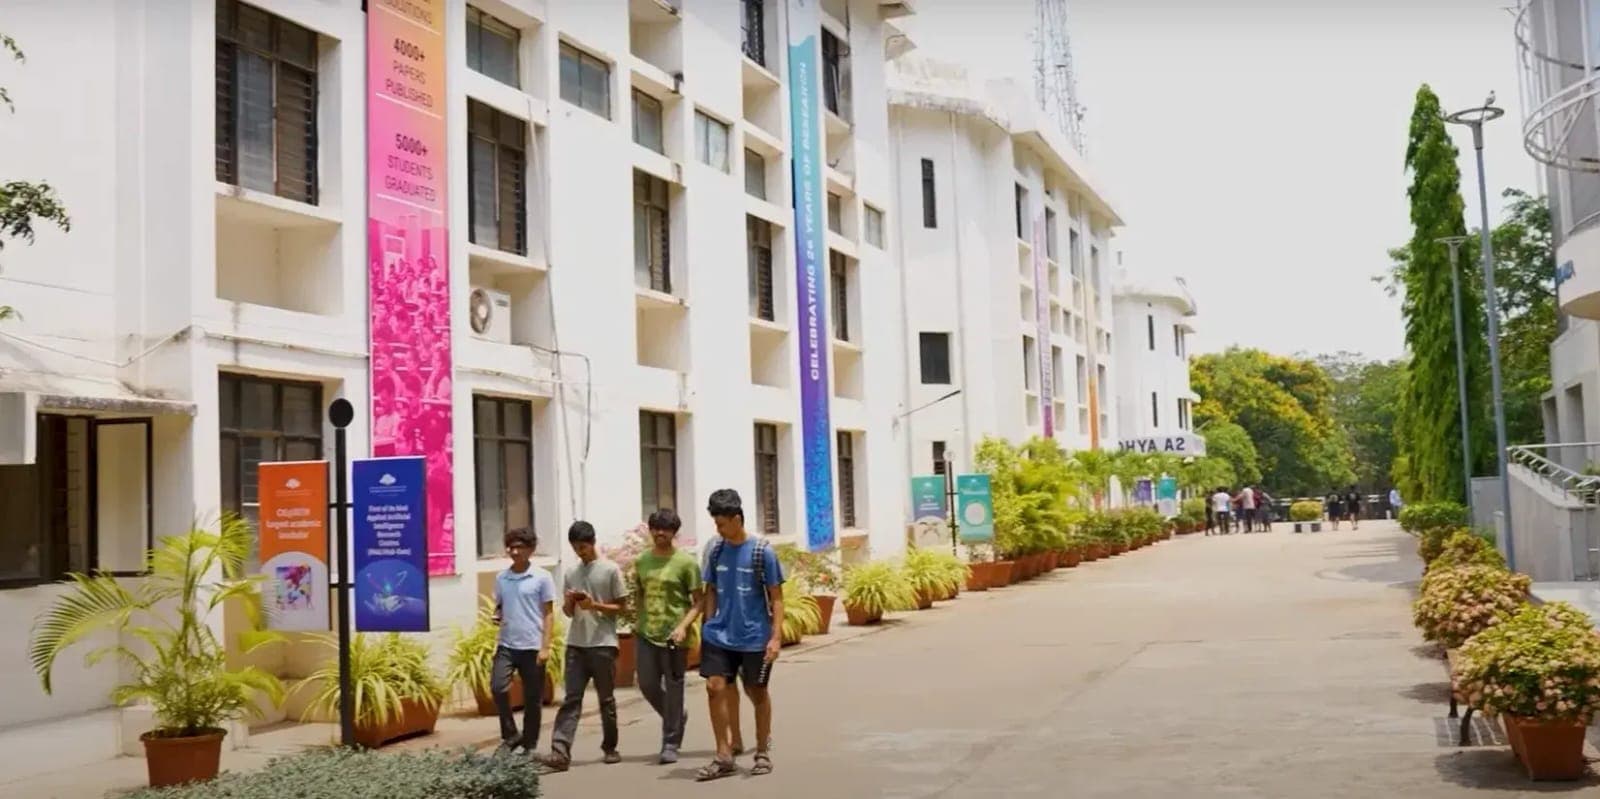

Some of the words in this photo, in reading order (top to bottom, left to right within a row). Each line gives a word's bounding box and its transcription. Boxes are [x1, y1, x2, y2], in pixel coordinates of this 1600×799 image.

[393, 38, 425, 61] 4000+
[393, 60, 426, 85] PAPERS
[385, 78, 433, 108] PUBLISHED
[800, 62, 810, 150] RESEARCH
[395, 133, 428, 156] 5000+
[387, 154, 433, 180] STUDENTS
[803, 154, 811, 176] OF
[384, 175, 436, 202] GRADUATED
[803, 180, 813, 233] YEARS
[806, 264, 819, 381] CELEBRATING
[1165, 437, 1185, 451] A2
